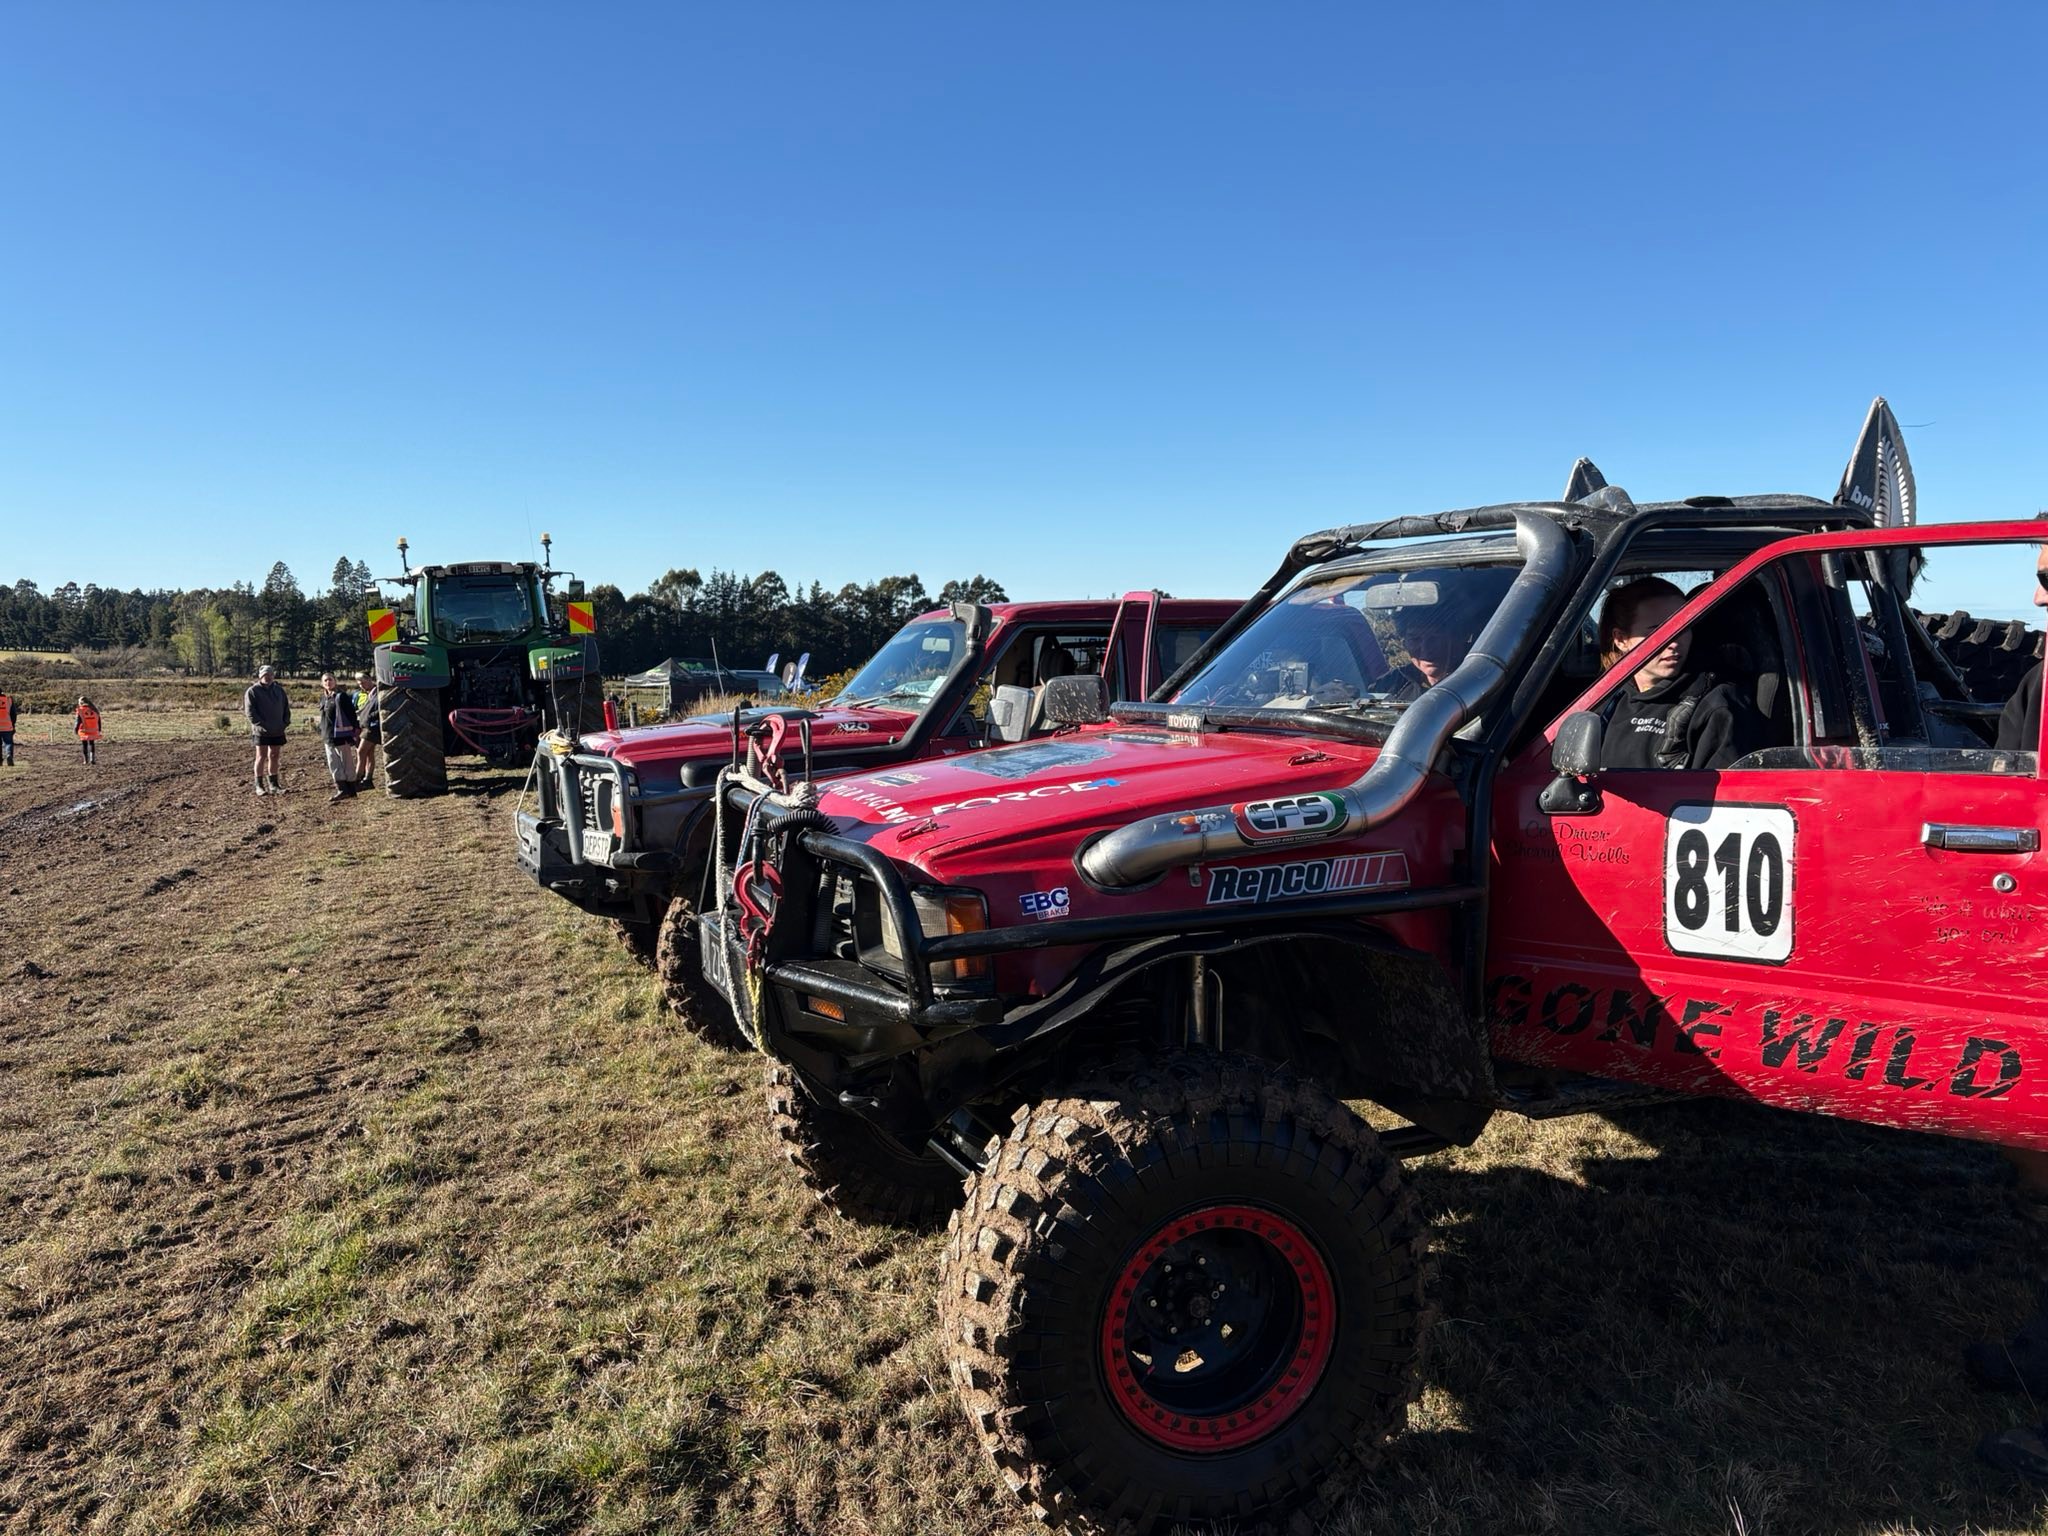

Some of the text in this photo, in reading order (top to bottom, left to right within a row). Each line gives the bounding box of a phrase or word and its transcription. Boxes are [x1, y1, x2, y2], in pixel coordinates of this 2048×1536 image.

[1168, 714, 1200, 729] TOYOTA
[1631, 717, 1655, 725] GONE
[1249, 797, 1327, 830] EFS
[1569, 843, 1630, 865] Wells
[1673, 828, 1785, 938] 810
[1020, 888, 1069, 914] EBC
[1486, 974, 2024, 1099] GONE WILD
